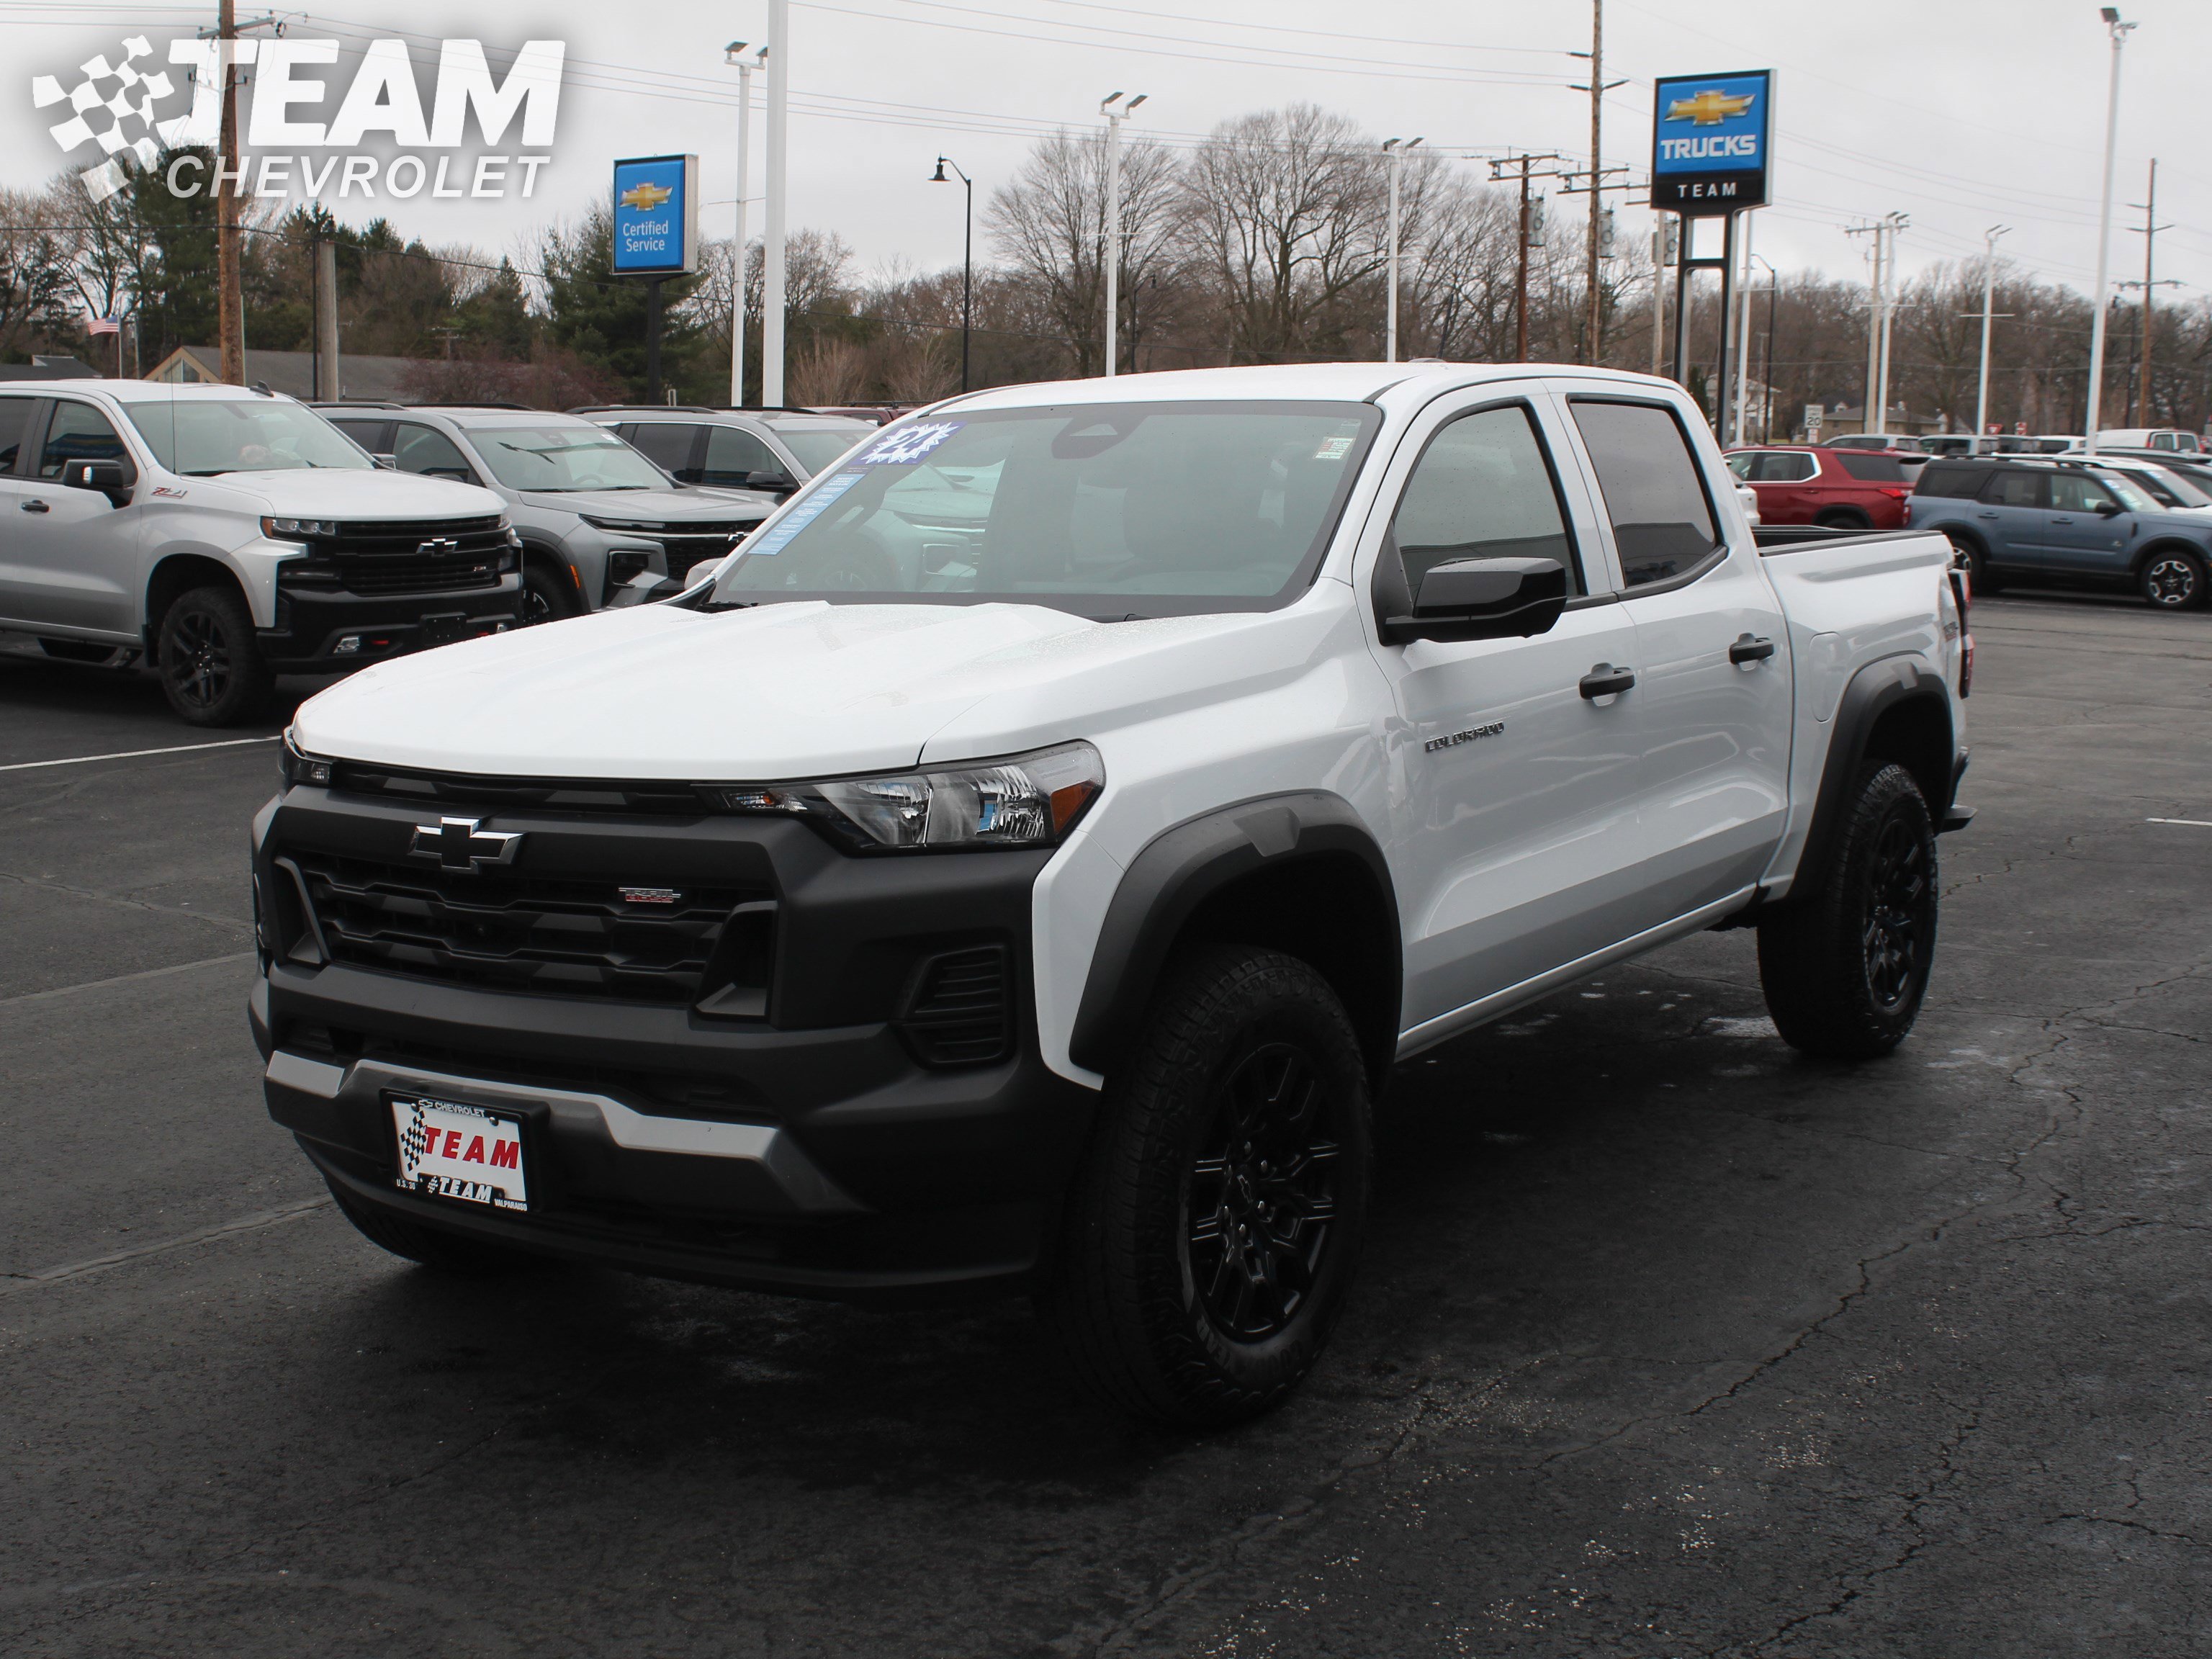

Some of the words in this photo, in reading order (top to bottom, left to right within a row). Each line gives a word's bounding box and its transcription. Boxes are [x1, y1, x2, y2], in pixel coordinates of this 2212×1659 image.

[1660, 135, 1757, 160] TRUCKS
[1678, 182, 1737, 198] TEAM
[623, 220, 669, 237] Certified
[626, 238, 665, 252] Service
[1807, 417, 1821, 426] 20
[1425, 721, 1504, 752] COLORADO
[434, 1102, 485, 1118] CHEVROLET
[425, 1126, 519, 1169] TEAM
[439, 1176, 493, 1201] TEAM
[494, 1198, 528, 1212] VALPARAISO
